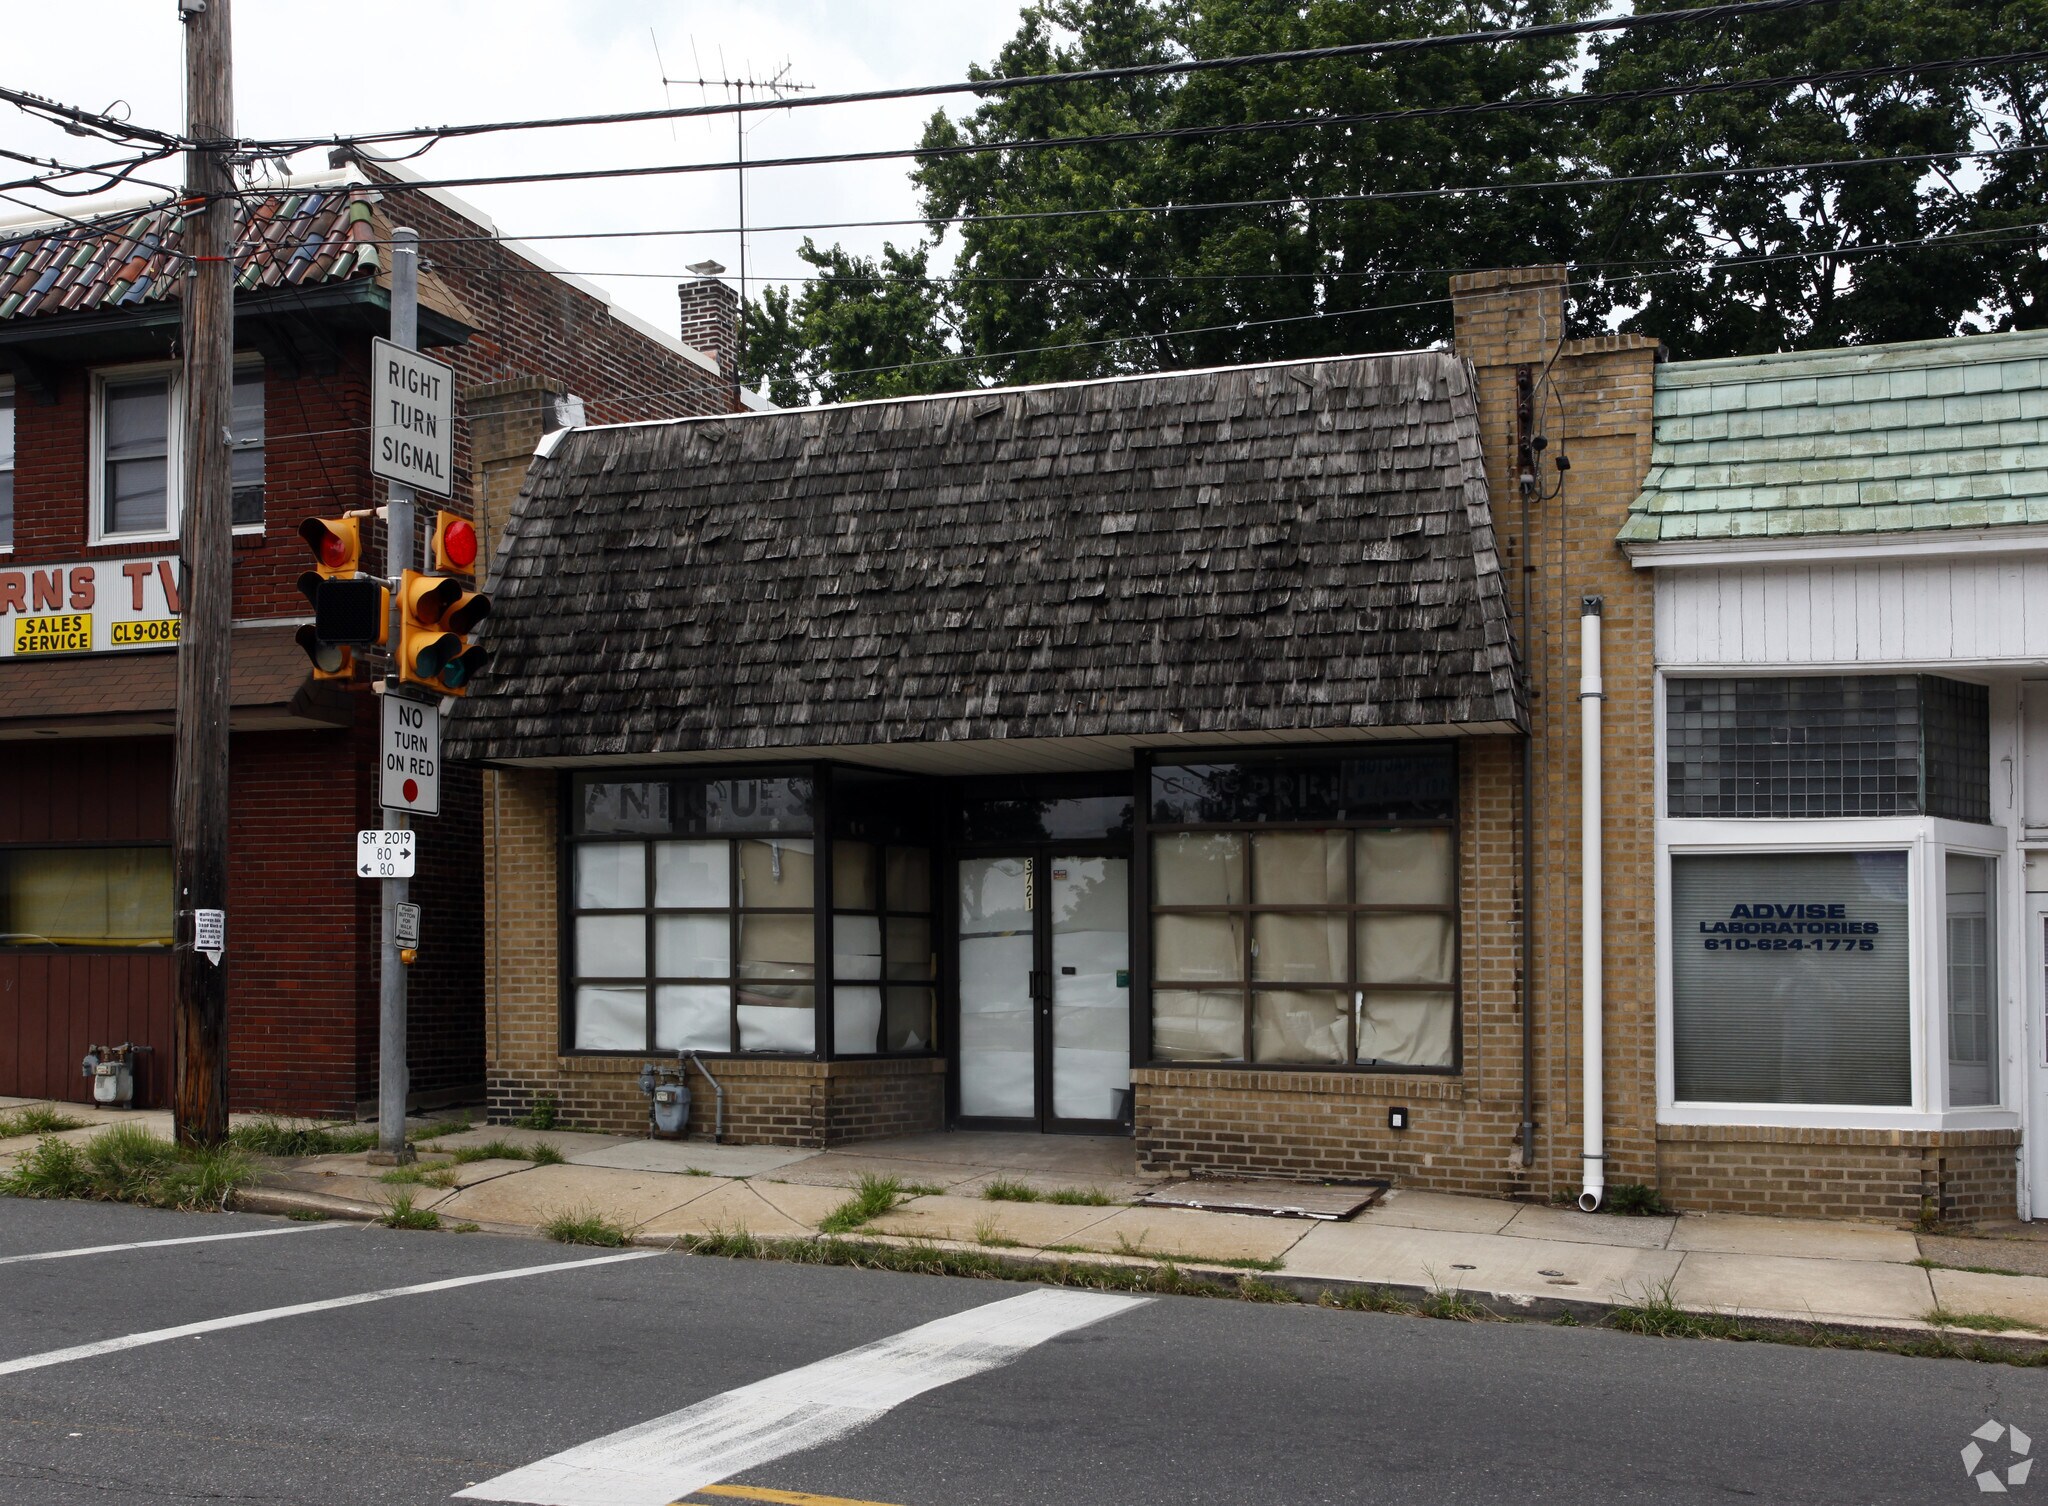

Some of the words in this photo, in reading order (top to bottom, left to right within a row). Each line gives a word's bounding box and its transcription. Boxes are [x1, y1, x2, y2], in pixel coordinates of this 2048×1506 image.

[389, 360, 440, 401] RIGHT
[391, 400, 437, 439] TURN
[382, 436, 444, 479] SIGNAL
[26, 616, 82, 634] SALES
[17, 633, 88, 651] SERVICE
[399, 705, 423, 729] NO
[394, 731, 428, 753] TURN
[387, 753, 404, 772] ON
[410, 758, 434, 777] RED
[362, 831, 377, 845] SR
[384, 831, 411, 845] 2019
[377, 847, 392, 861] 80
[380, 863, 394, 876] 80
[1730, 904, 1846, 919] ADVISE
[1699, 921, 1879, 934] LABORATORIES
[1704, 938, 1874, 951] 610-624-1775
